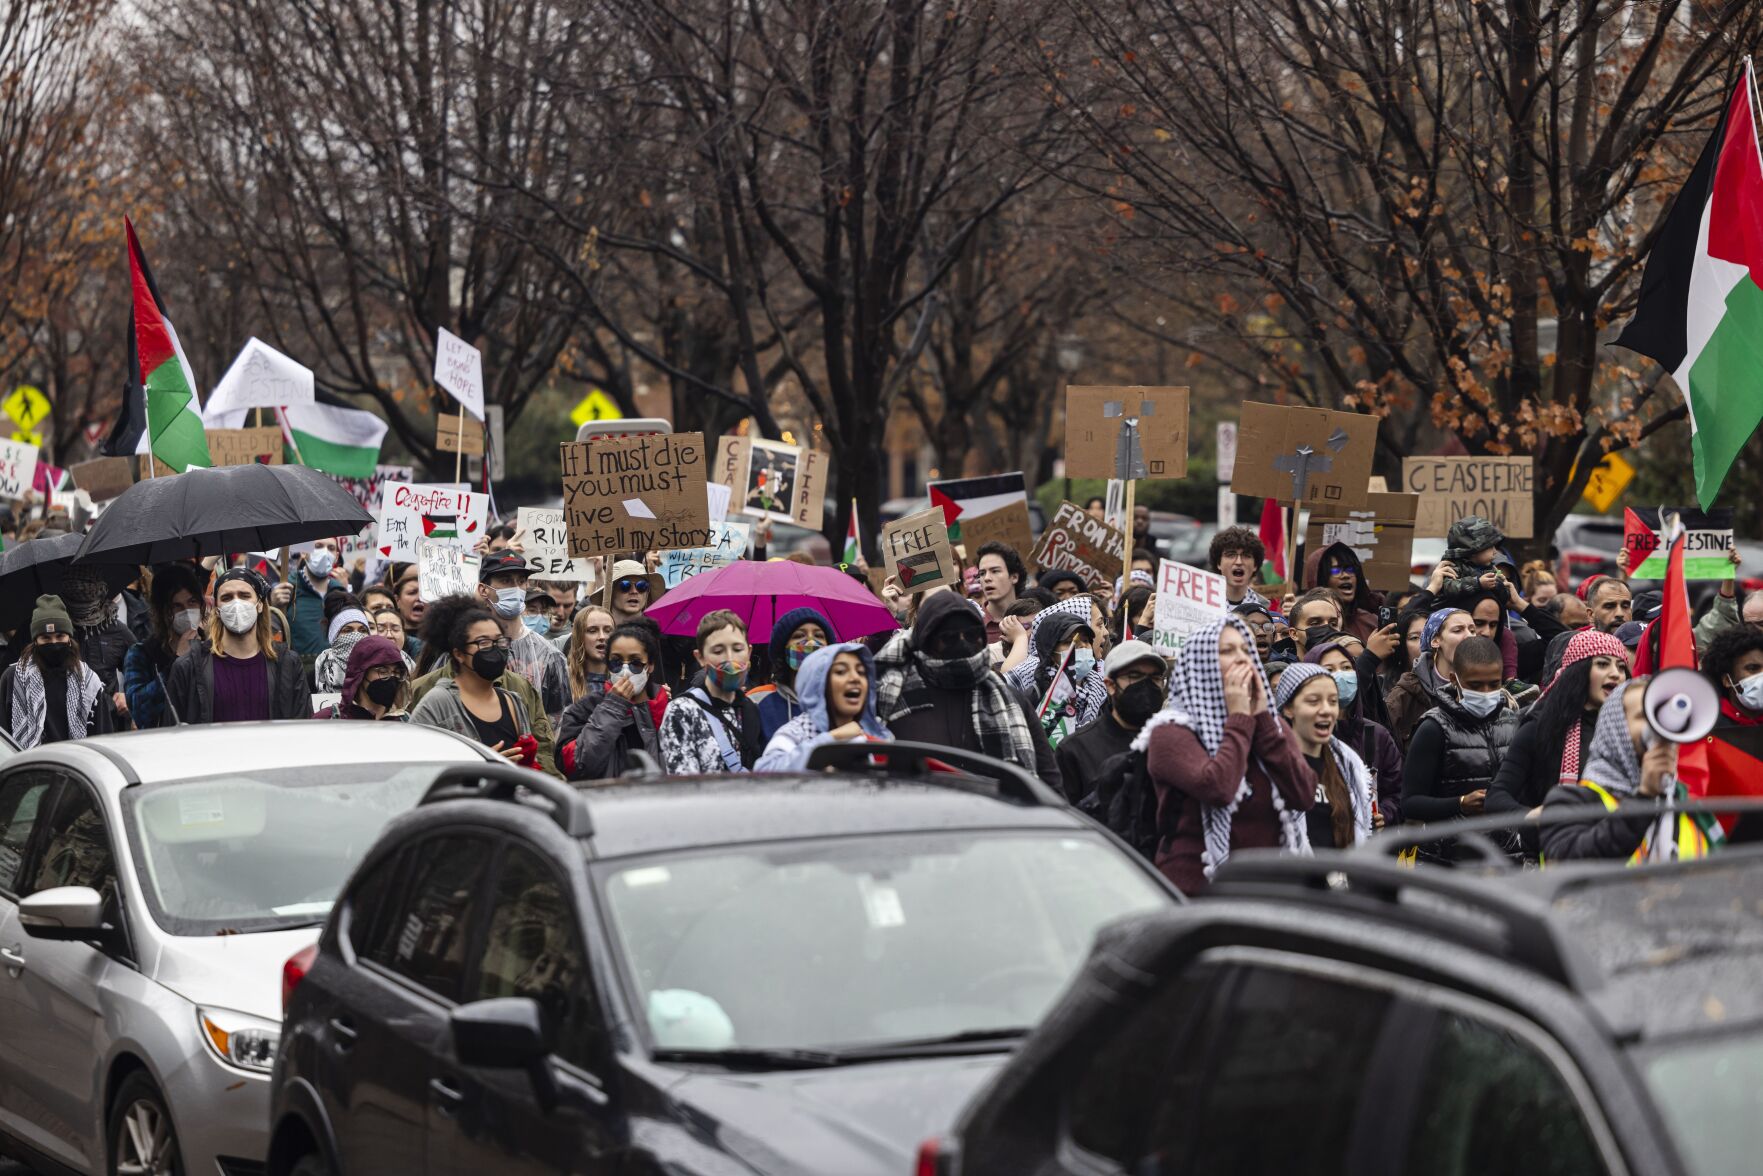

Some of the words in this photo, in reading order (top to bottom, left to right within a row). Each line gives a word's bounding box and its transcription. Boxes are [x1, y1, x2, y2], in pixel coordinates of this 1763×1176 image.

[446, 341, 462, 354] LET
[466, 351, 476, 364] IT
[449, 371, 475, 399] HOPE
[561, 445, 578, 477] If
[580, 442, 594, 475] I
[597, 438, 650, 475] must
[654, 437, 699, 467] die
[0, 476, 20, 494] OW
[564, 477, 618, 505] you
[618, 466, 688, 495] must
[1409, 463, 1533, 493] CEASEFIRE
[386, 516, 408, 534] End
[527, 510, 563, 525] FROM
[567, 506, 615, 528] live
[1451, 499, 1508, 529] NOW
[533, 527, 567, 545] RIV
[1053, 503, 1108, 549] FROM
[394, 534, 410, 550] the
[570, 532, 591, 554] to
[592, 527, 625, 551] tell
[630, 531, 655, 551] my
[658, 522, 711, 549] story
[889, 524, 941, 557] FREE
[1626, 533, 1660, 550] FREE
[448, 549, 458, 565] NO
[530, 557, 575, 574] SEA
[668, 551, 693, 561] WILL
[703, 552, 722, 565] BE
[1162, 563, 1222, 608] FREE
